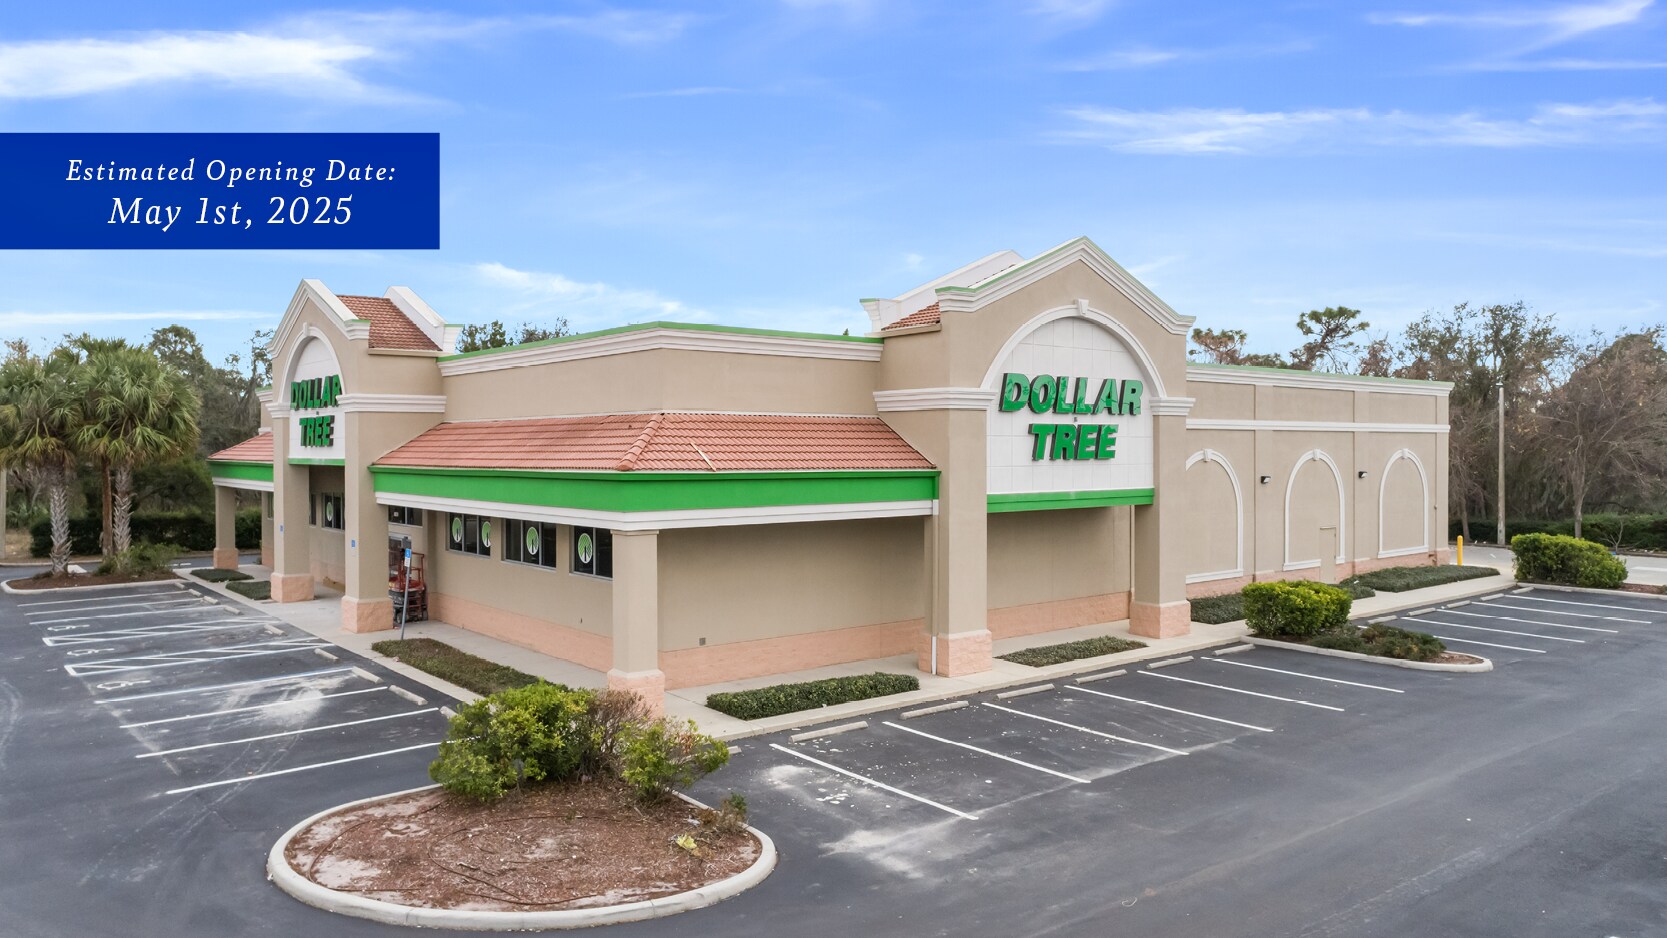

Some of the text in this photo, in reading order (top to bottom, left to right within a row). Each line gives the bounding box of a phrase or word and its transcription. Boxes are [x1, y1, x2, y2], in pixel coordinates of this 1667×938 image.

[290, 374, 342, 410] DOLLAR
[1000, 372, 1143, 415] DOLLAR
[299, 415, 334, 447] TREE
[1029, 423, 1119, 461] TREE
